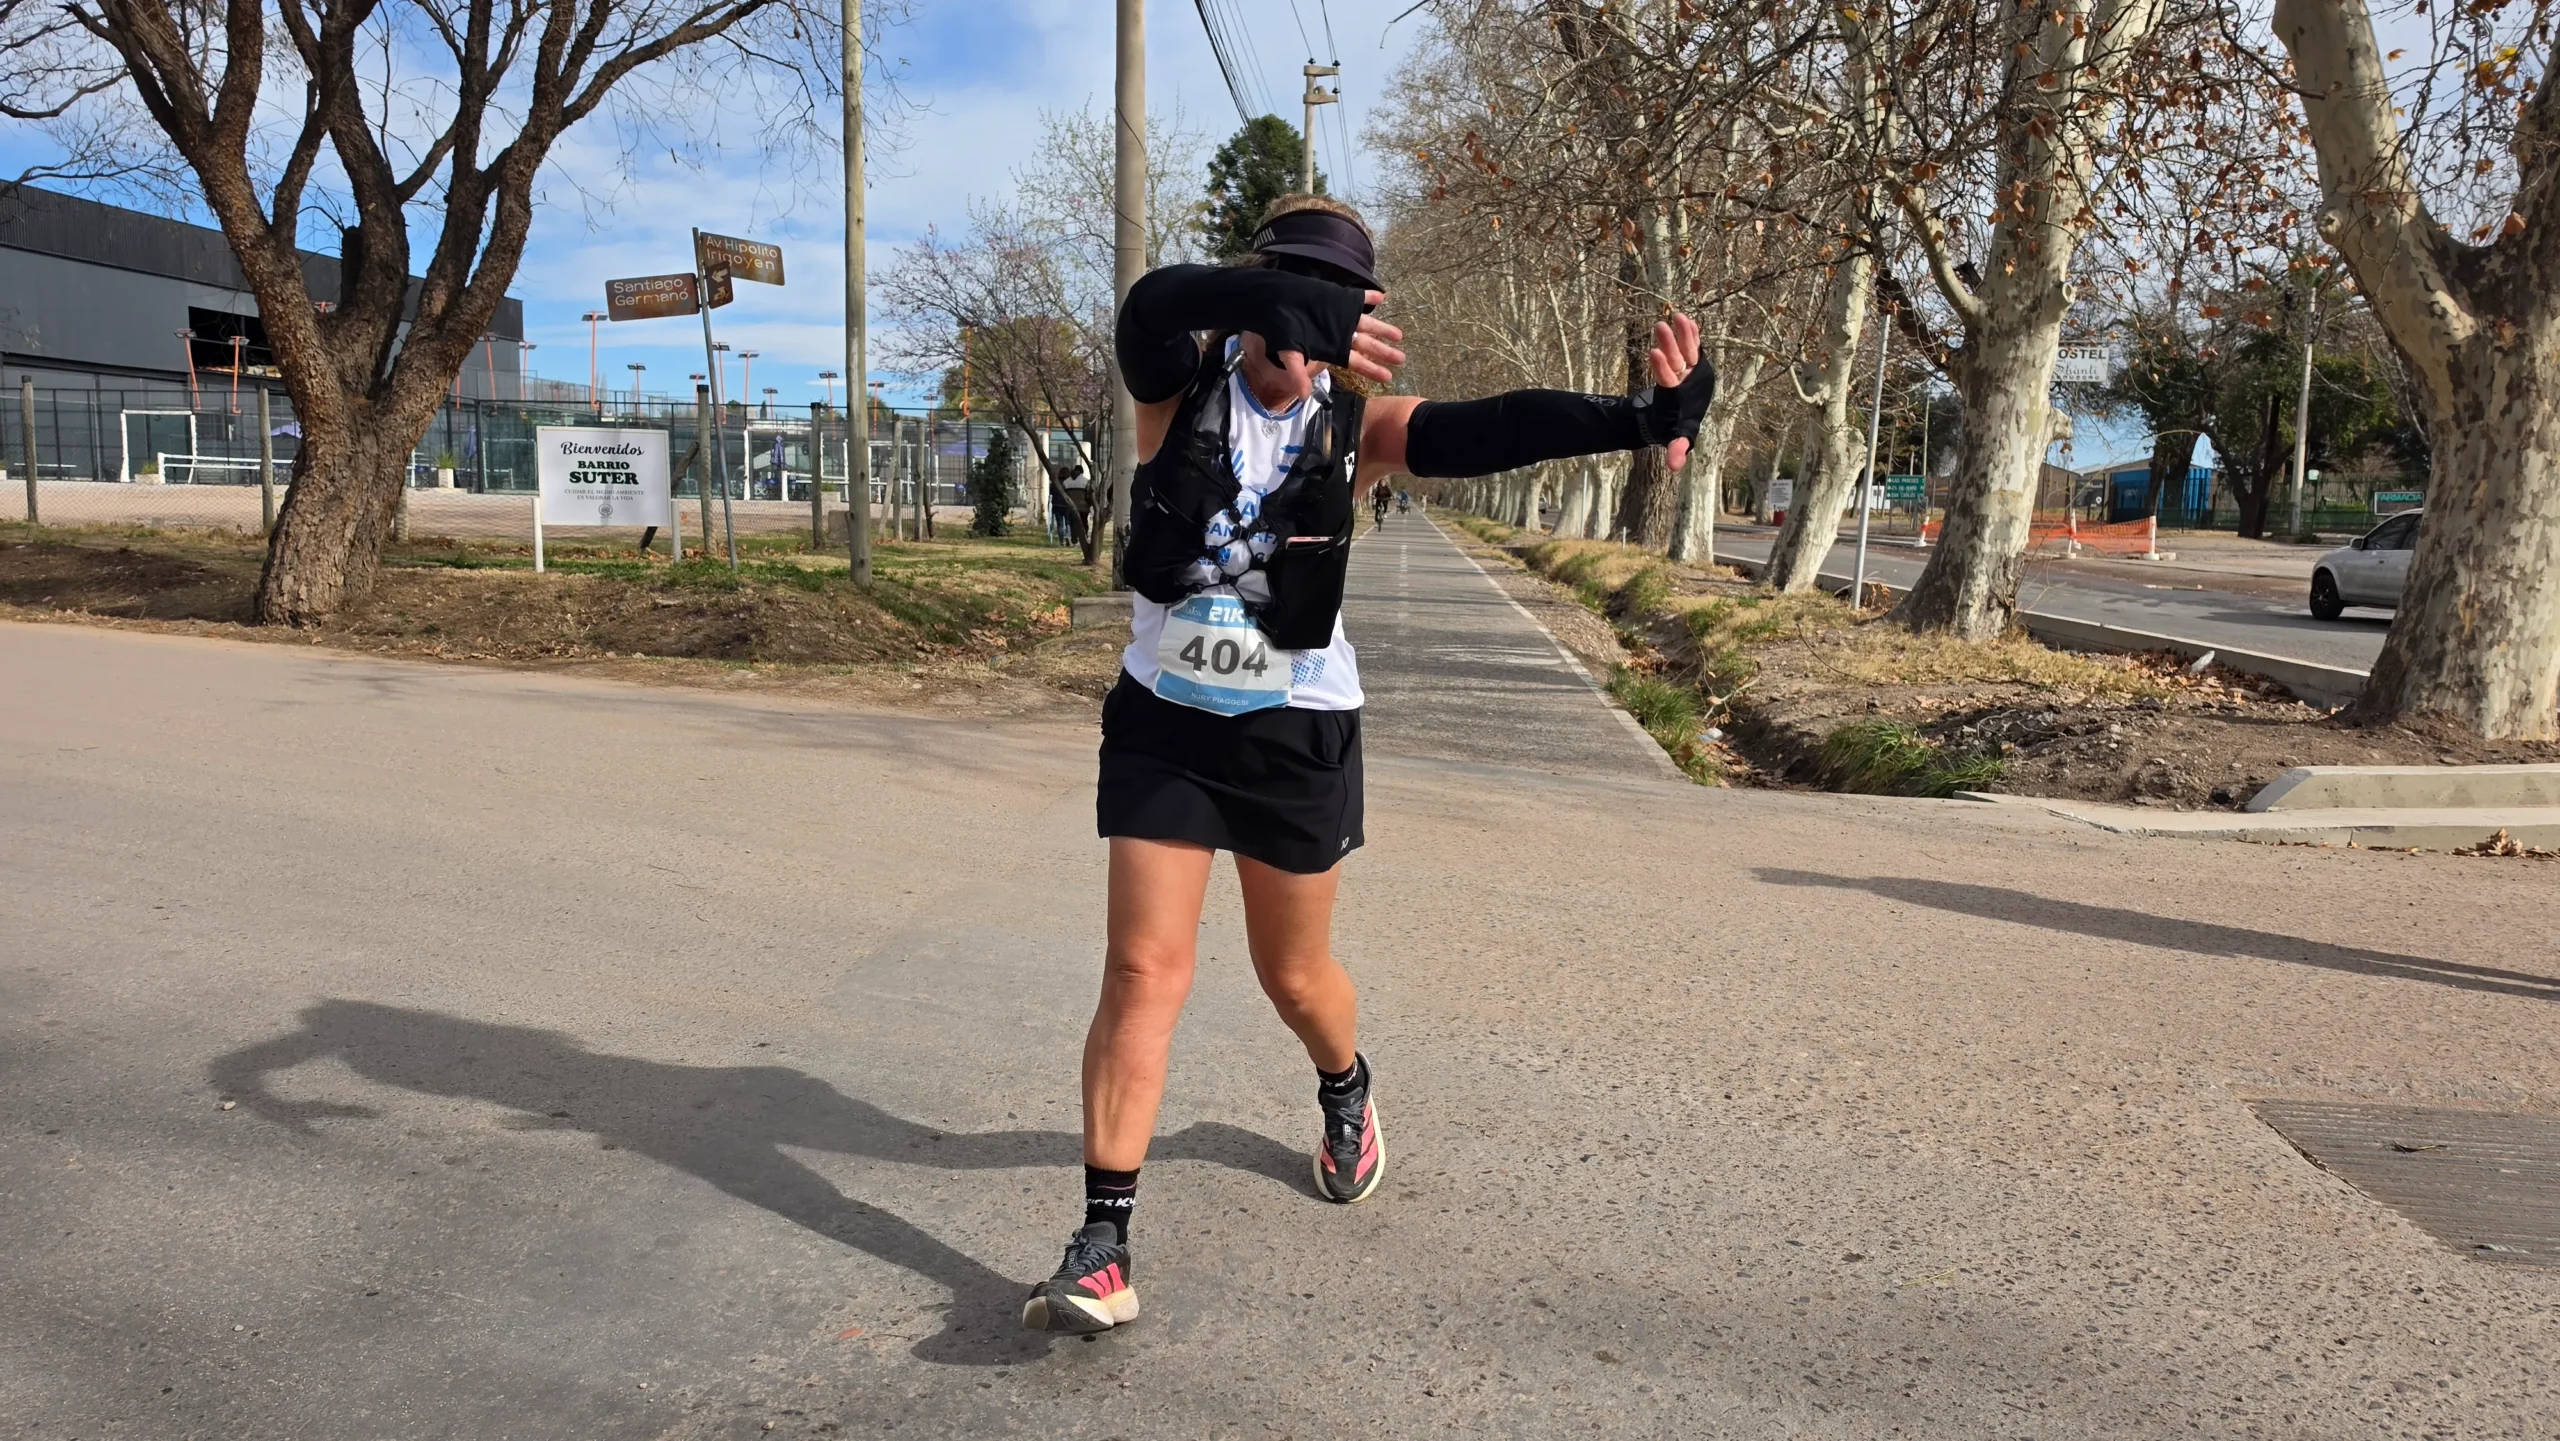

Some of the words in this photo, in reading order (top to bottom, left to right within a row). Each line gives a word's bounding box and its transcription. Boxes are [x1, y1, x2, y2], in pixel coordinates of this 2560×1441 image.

[725, 237, 778, 259] Hipolito
[706, 247, 776, 271] Irigoyen
[613, 277, 684, 294] Santiago
[615, 287, 689, 307] Germanó
[2058, 348, 2107, 360] OSTEL
[560, 440, 645, 456] Bienvenidos
[578, 460, 630, 470] BARRIO
[569, 471, 639, 485] SUTER
[1208, 605, 1246, 623] 21K
[1179, 635, 1269, 678] 404
